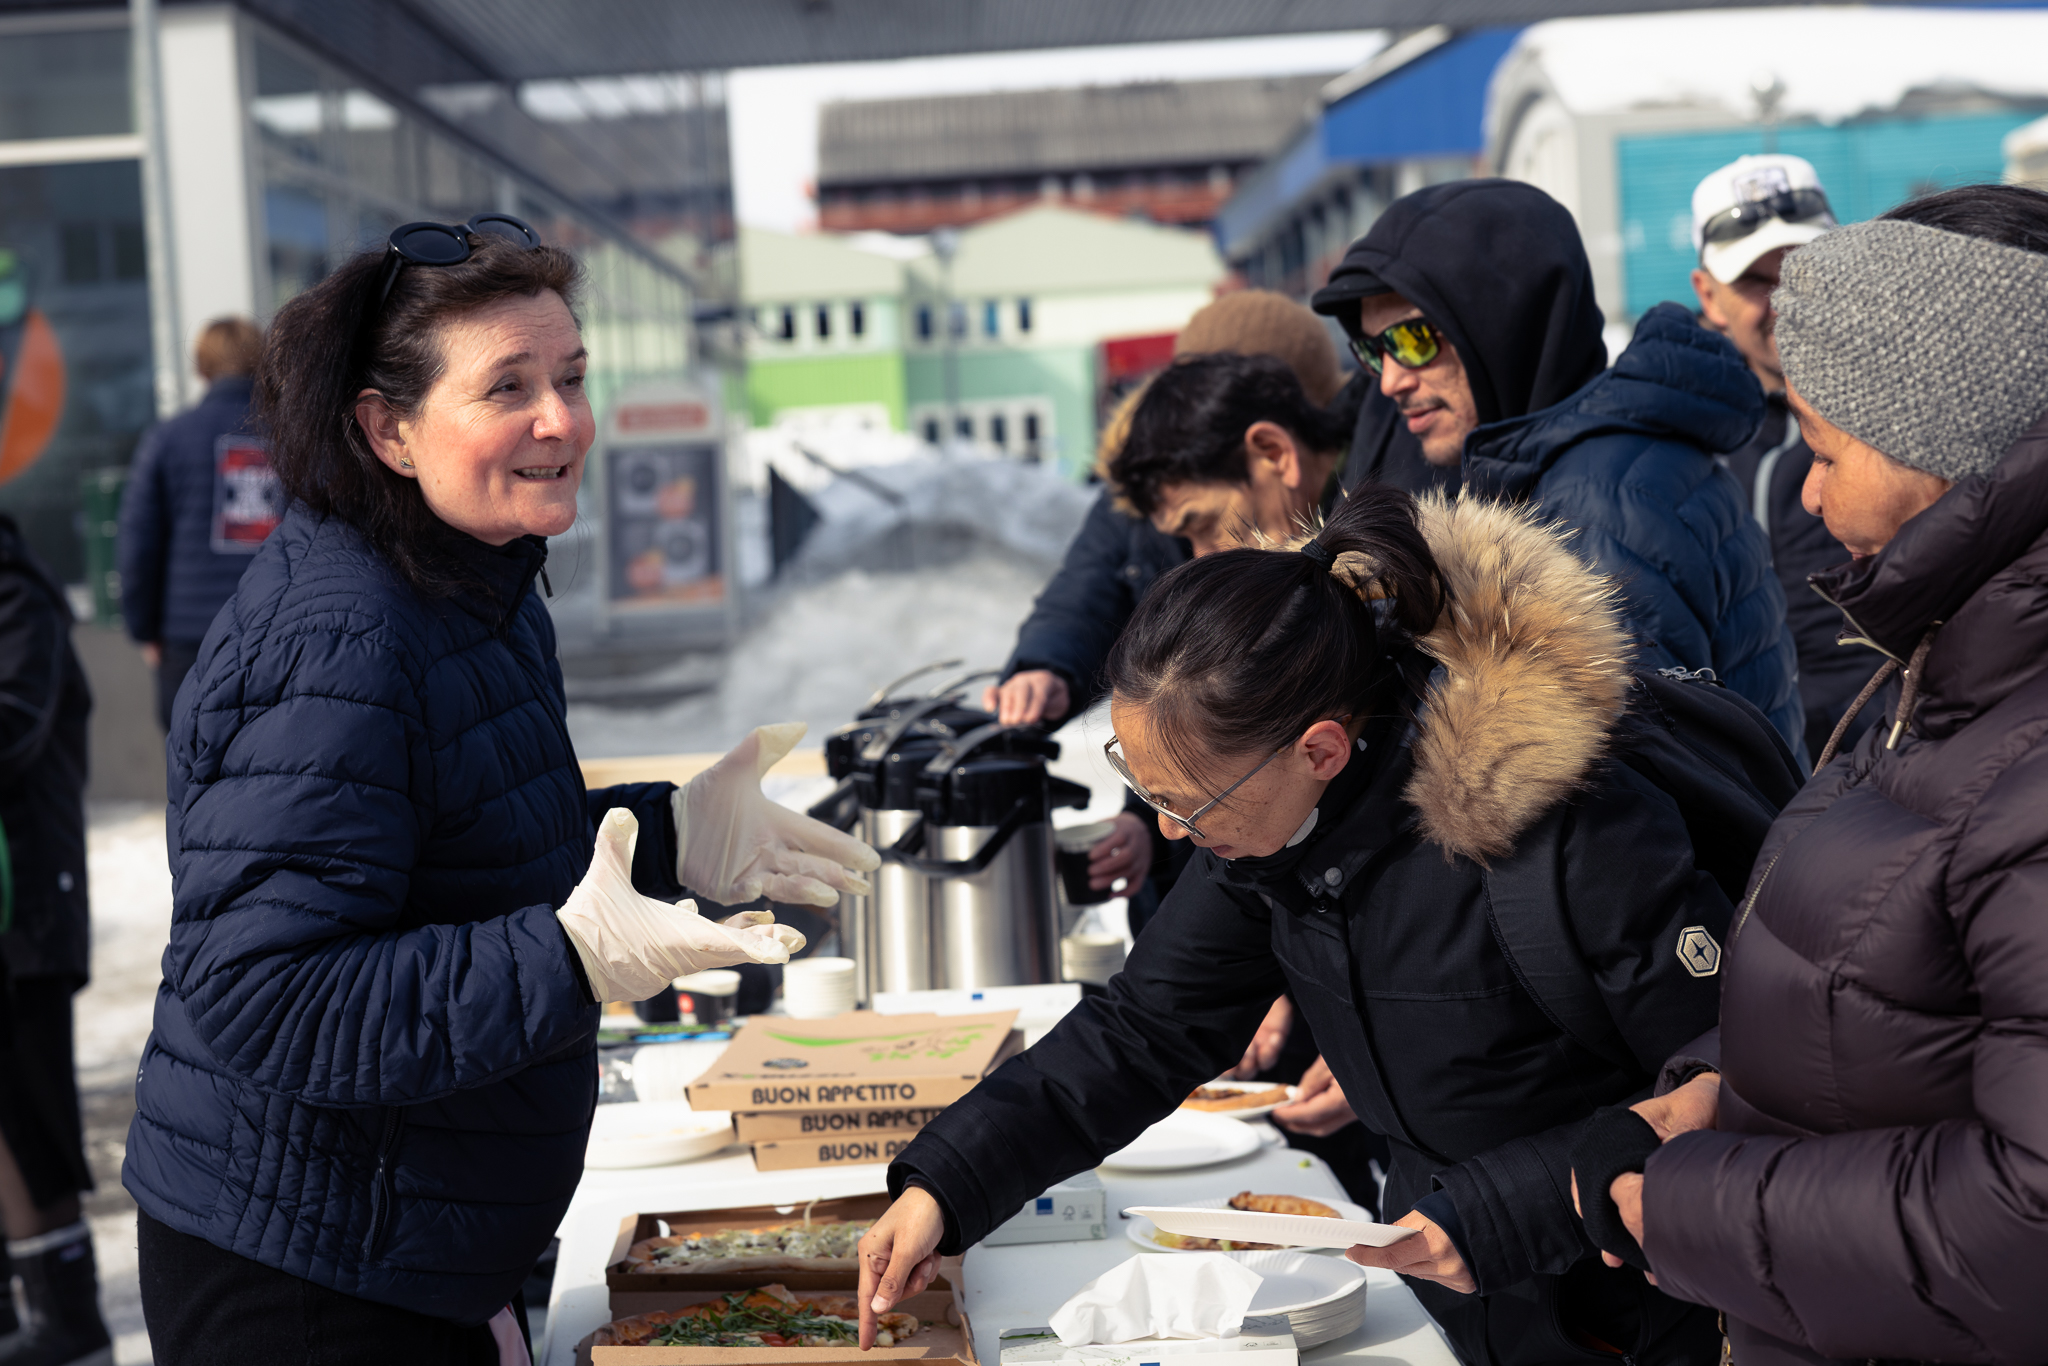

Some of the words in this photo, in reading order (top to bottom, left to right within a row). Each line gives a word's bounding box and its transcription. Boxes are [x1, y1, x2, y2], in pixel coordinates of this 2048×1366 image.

[752, 1086, 811, 1104] BUON
[817, 1083, 916, 1102] APPETITO
[801, 1112, 861, 1133] BUON
[867, 1107, 943, 1128] APPETI
[819, 1141, 879, 1161] BUON
